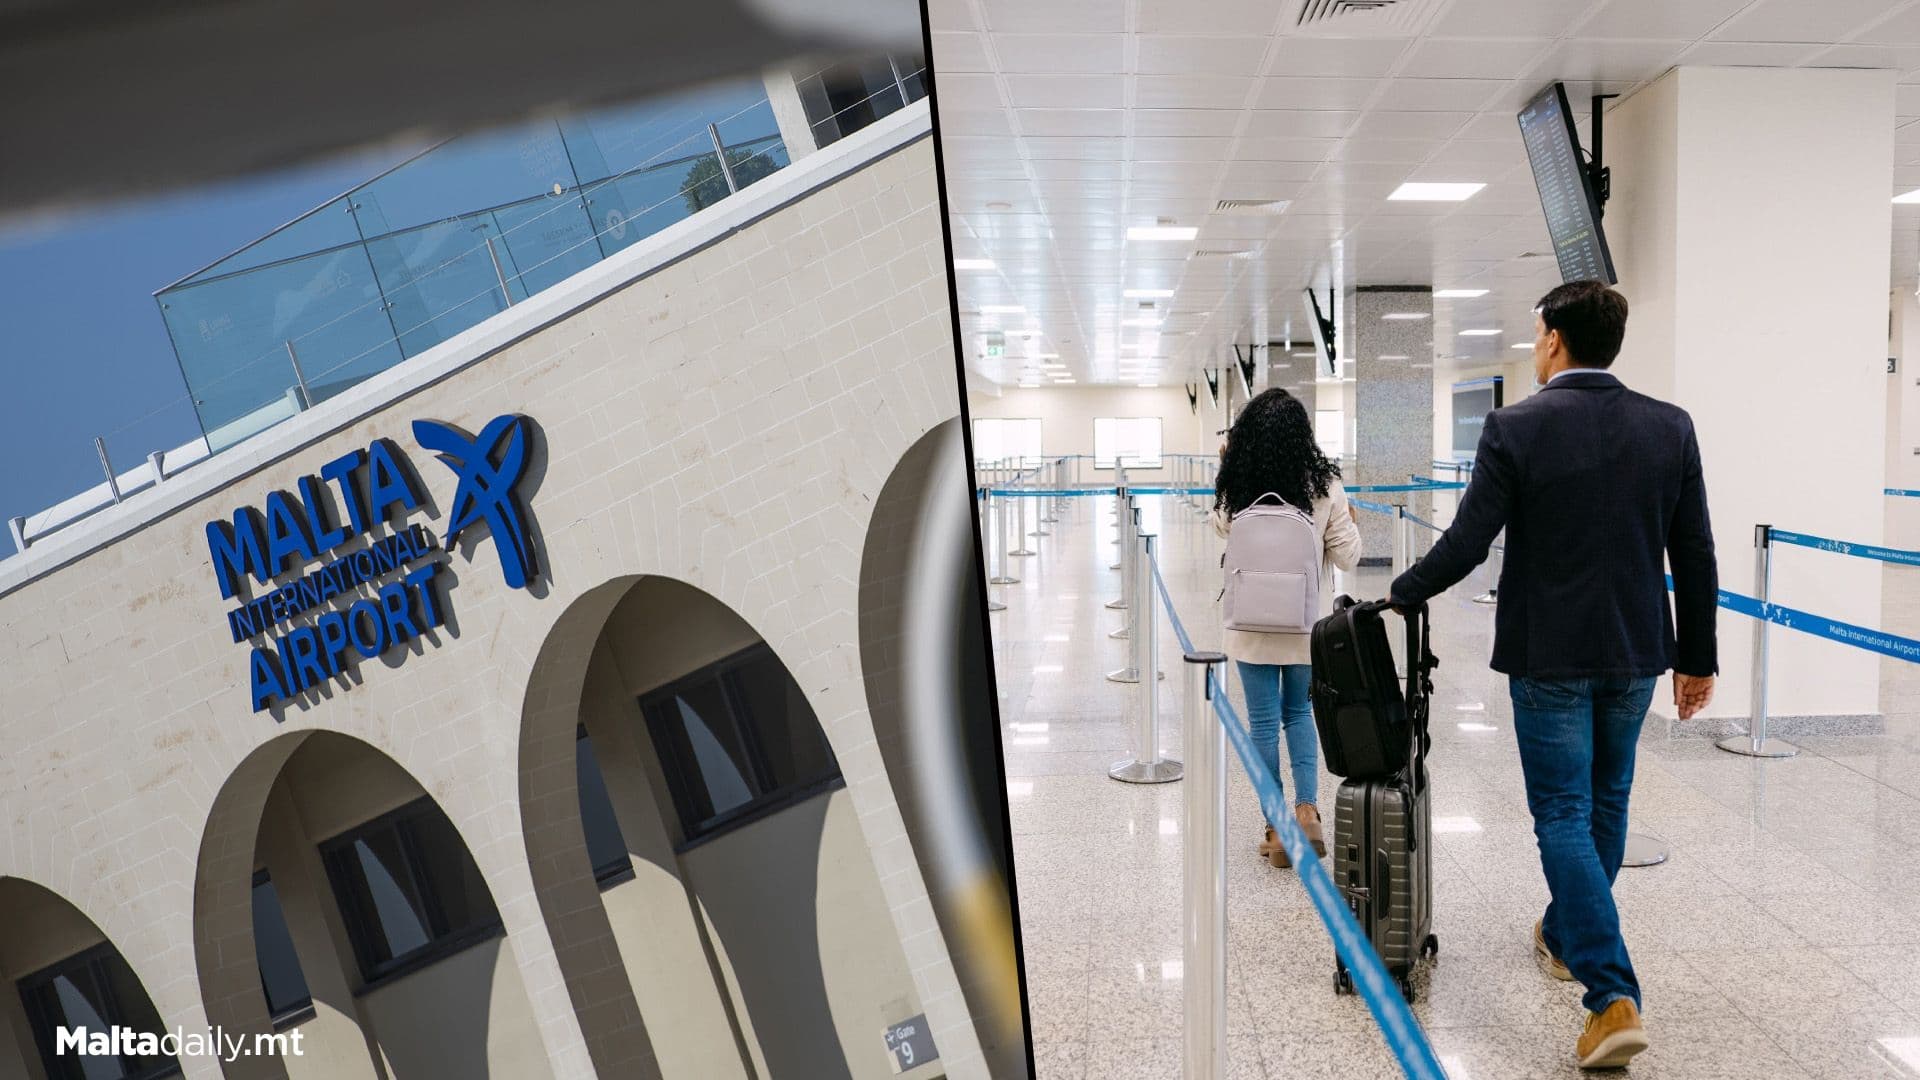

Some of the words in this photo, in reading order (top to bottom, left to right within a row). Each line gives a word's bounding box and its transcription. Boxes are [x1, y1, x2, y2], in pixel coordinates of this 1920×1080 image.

[206, 438, 420, 600] MALTA
[227, 523, 432, 643] INTERNATIONAL
[251, 562, 441, 713] AIRPORT
[1829, 624, 1847, 637] Malta
[1848, 630, 1892, 649] International
[1893, 640, 1920, 656] Airport
[895, 1025, 916, 1040] Gate
[901, 1041, 914, 1065] 9
